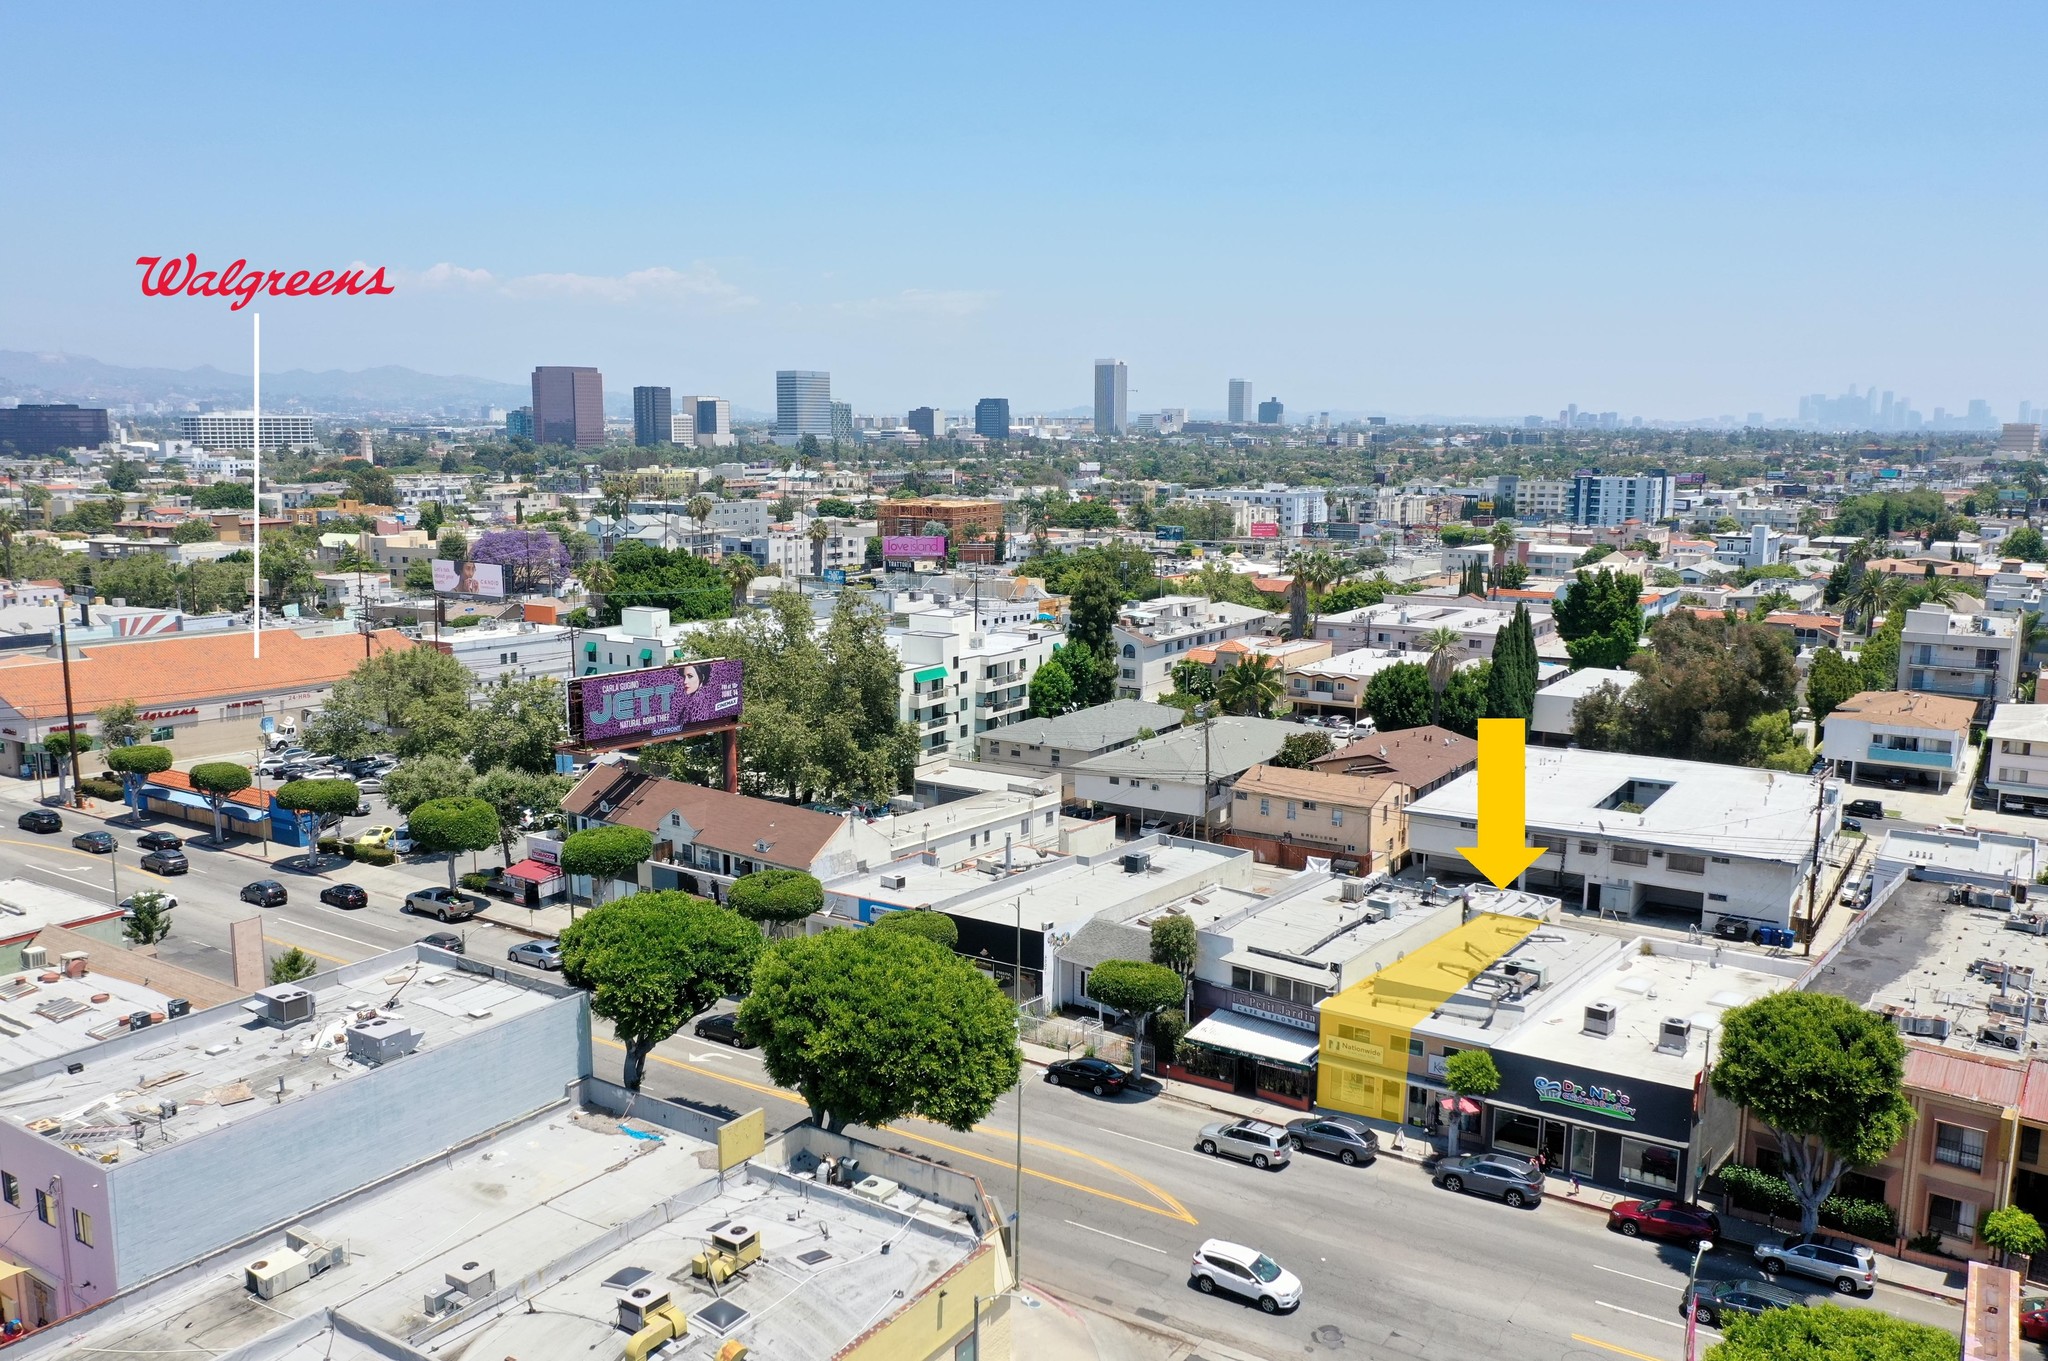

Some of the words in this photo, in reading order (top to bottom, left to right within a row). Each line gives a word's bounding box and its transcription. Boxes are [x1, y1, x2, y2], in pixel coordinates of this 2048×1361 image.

[888, 540, 909, 552] love
[910, 539, 939, 552] island
[602, 683, 620, 693] CARLA
[620, 680, 639, 691] GUGINO
[589, 684, 677, 725] JETT
[716, 700, 736, 709] CINEMAX
[49, 722, 87, 733] PHARACY
[620, 719, 642, 729] NATURAL
[643, 716, 657, 725] BORN
[657, 713, 670, 723] THIEF
[652, 725, 681, 735] OUTFRONT
[1232, 993, 1245, 1004] Le
[1249, 997, 1275, 1012] Petit
[1280, 1005, 1316, 1023] Jardin
[1237, 1005, 1258, 1015] CAFE
[1270, 1014, 1311, 1029] FLOWERS
[1342, 1042, 1381, 1057] Nationwide
[1562, 1079, 1587, 1097] Dr.
[1589, 1085, 1630, 1106] Nik's
[1562, 1092, 1599, 1107] Children's
